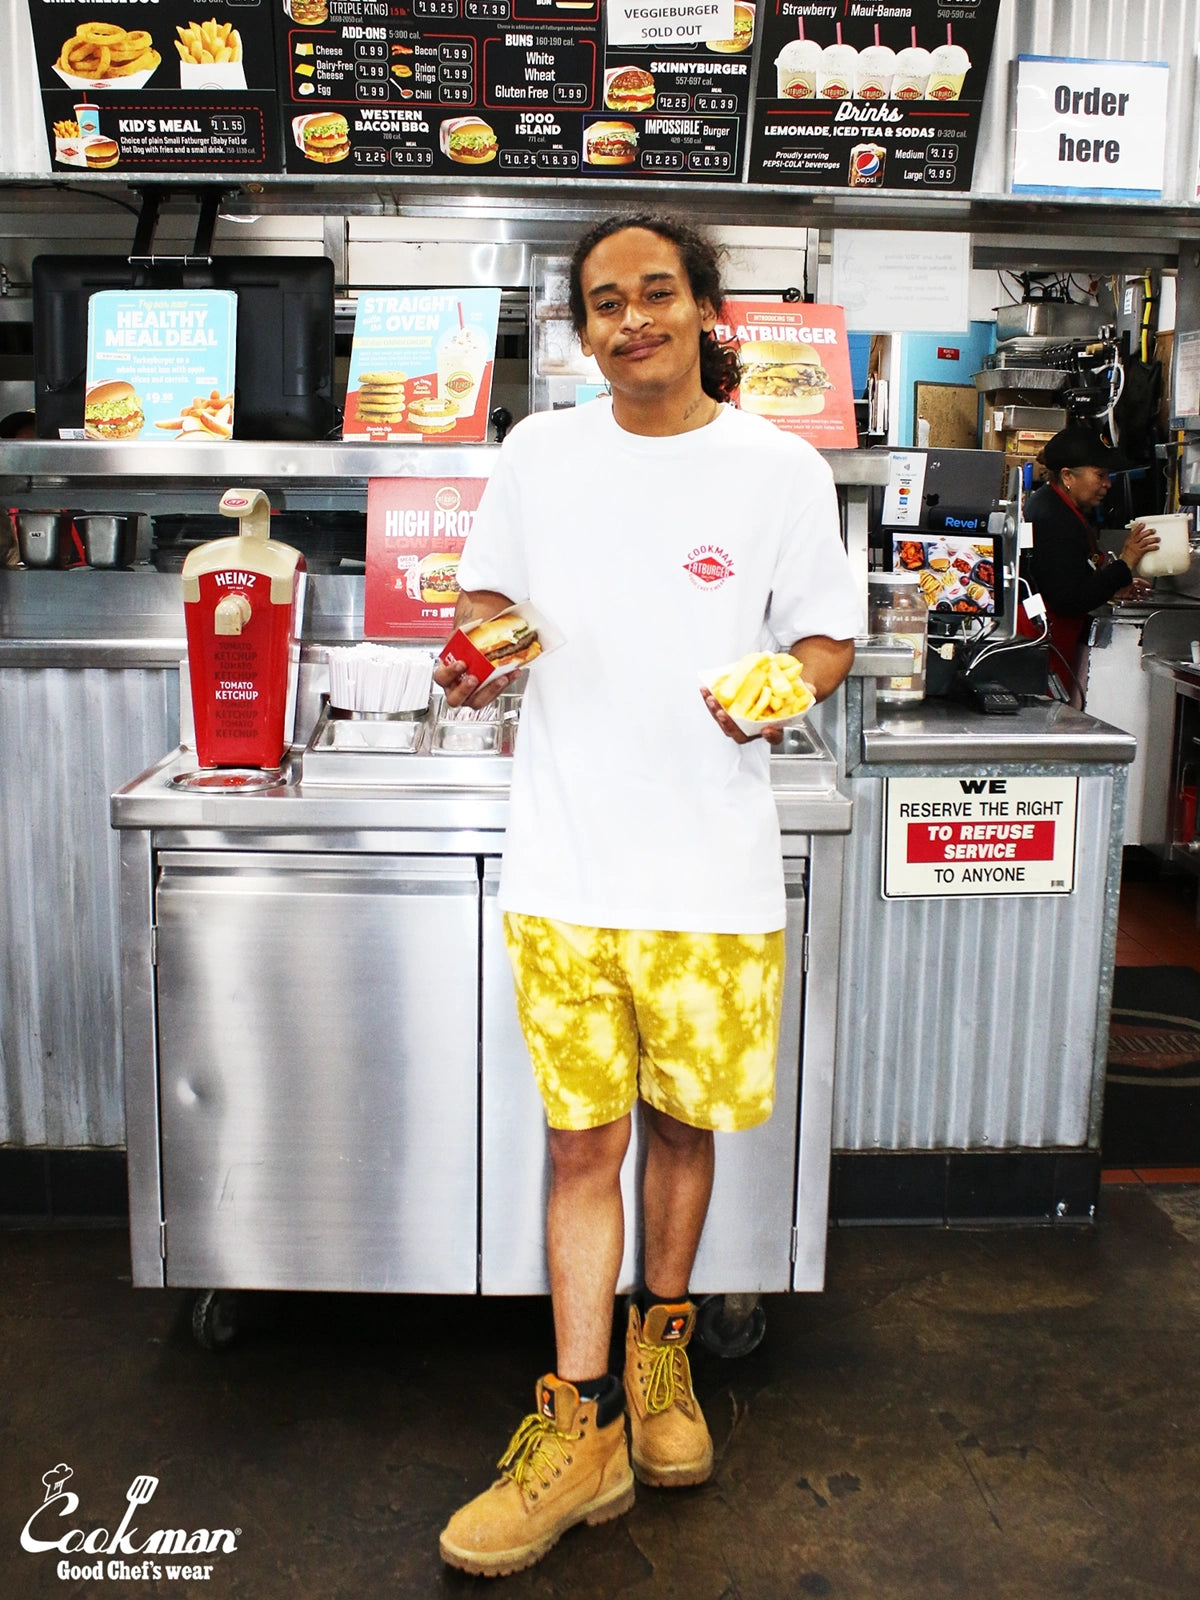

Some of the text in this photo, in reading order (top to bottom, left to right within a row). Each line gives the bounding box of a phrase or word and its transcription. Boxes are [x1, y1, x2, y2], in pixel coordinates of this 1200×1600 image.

[330, 1, 362, 15] (TRIPLE
[364, 3, 389, 17] KING)
[623, 4, 719, 19] VEGGIEBURGER
[782, 3, 837, 17] Strawberry
[850, 4, 912, 17] Maui-Banana
[964, 10, 977, 19] cal.
[342, 27, 421, 40] ADD-ONS 5-300 cal.
[641, 25, 703, 39] SOLD OUT
[505, 34, 575, 47] BUNS 160-190 cal.
[315, 46, 343, 56] Cheese
[414, 46, 438, 56] Bacon
[526, 52, 555, 66] White
[316, 61, 354, 72] Dairy-Free
[415, 64, 436, 74] Onion
[650, 62, 748, 76] SKINNYBURGER
[317, 70, 344, 80] Cheese
[415, 73, 436, 83] Rings
[524, 68, 556, 82] Wheat
[675, 76, 714, 86] 557-697 cal.
[317, 85, 331, 96] Egg
[415, 90, 432, 100] Chili
[495, 85, 549, 99] Gluten Free
[1054, 85, 1130, 117] Order
[360, 109, 423, 121] WESTERN
[520, 113, 555, 124] 1000
[834, 101, 904, 123] Drinks
[118, 119, 202, 133] KID'S MEAL
[354, 120, 430, 133] BACON BBQ
[515, 124, 562, 135] ISLAND
[645, 119, 730, 138] IMPOSSIBLE Burger
[764, 125, 967, 138] LEMONADE, ICED TEA & SODAS 0-320 cal.
[120, 137, 140, 145] Choice
[141, 137, 148, 145] of
[149, 137, 164, 147] plain
[164, 137, 180, 145] Small
[181, 137, 210, 147] Fatburger
[210, 137, 228, 147] (Baby
[228, 137, 240, 146] Fat)
[1058, 133, 1120, 164] here
[121, 146, 132, 154] Hot
[133, 146, 144, 155] Dog
[145, 146, 159, 154] with
[160, 146, 173, 154] fries
[174, 146, 186, 154] and
[191, 146, 207, 154] small
[208, 146, 225, 154] drink.
[775, 151, 829, 161] Proudly serving
[895, 149, 924, 159] Medium
[804, 160, 840, 170] beverages
[855, 176, 877, 184] pepsi
[904, 170, 923, 181] Large
[364, 295, 459, 314] STRAIGHT
[116, 310, 209, 329] HEALTHY
[385, 314, 441, 332] OVEN
[105, 329, 218, 347] MEAL DEAL
[715, 324, 838, 345] FLATBURGER
[385, 510, 430, 537] HIGH
[945, 516, 978, 529] Revel
[687, 544, 734, 567] COOKMAN
[214, 571, 257, 588] HEINZ
[421, 608, 439, 617] IT'S
[214, 651, 258, 661] KETCHUP
[214, 671, 258, 680] KETCHUP
[220, 681, 253, 690] TOMATO
[215, 690, 259, 700] KETCHUP
[215, 710, 258, 719] KETCHUP
[959, 779, 1007, 794] WE
[899, 801, 1063, 818] RESERVE THE RIGHT
[928, 824, 1035, 841] TO REFUSE
[944, 843, 1016, 860] SERVICE
[934, 867, 1026, 883] TO ANYONE
